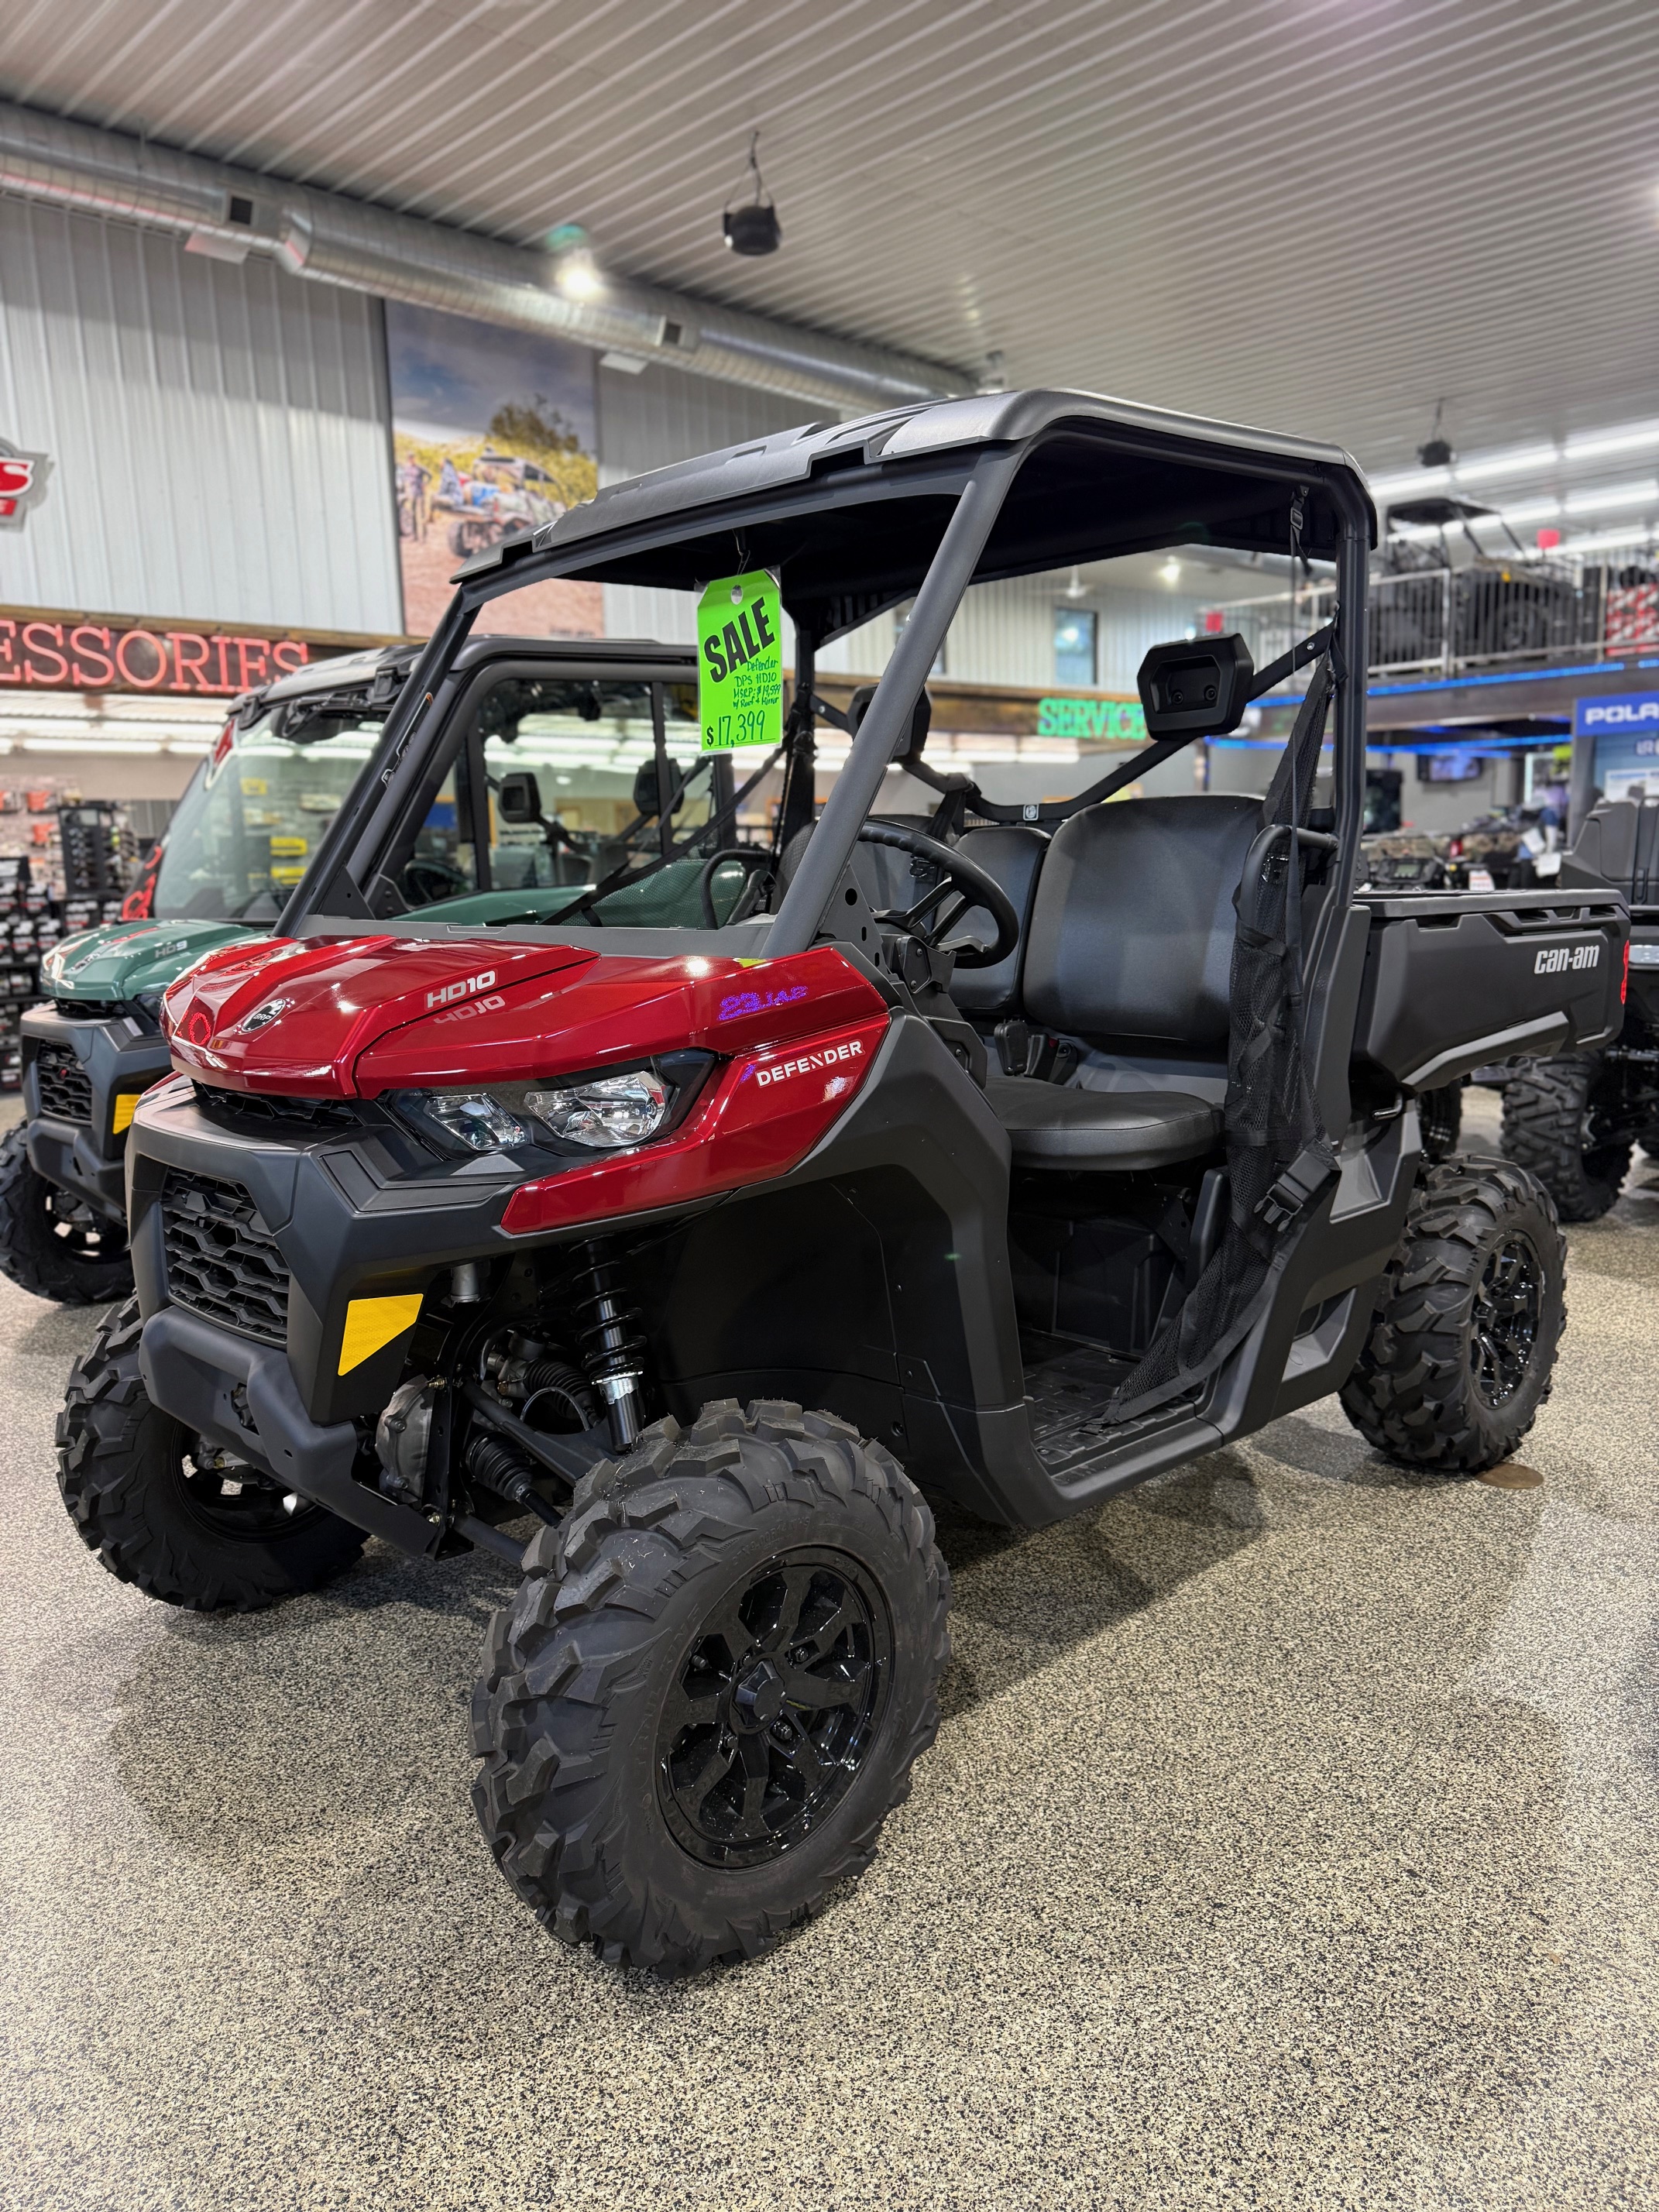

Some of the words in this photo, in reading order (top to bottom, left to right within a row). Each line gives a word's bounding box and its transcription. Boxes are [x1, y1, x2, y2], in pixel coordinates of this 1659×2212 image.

[704, 596, 775, 683] SALE
[734, 675, 753, 687] DPS
[756, 672, 777, 684] HD10
[747, 655, 778, 672] Defender
[1038, 698, 1146, 740] SERVICE
[155, 939, 187, 958] HD9
[1534, 945, 1599, 974] can-am
[427, 970, 496, 1008] HD10
[756, 1040, 864, 1087] DEFENDER
